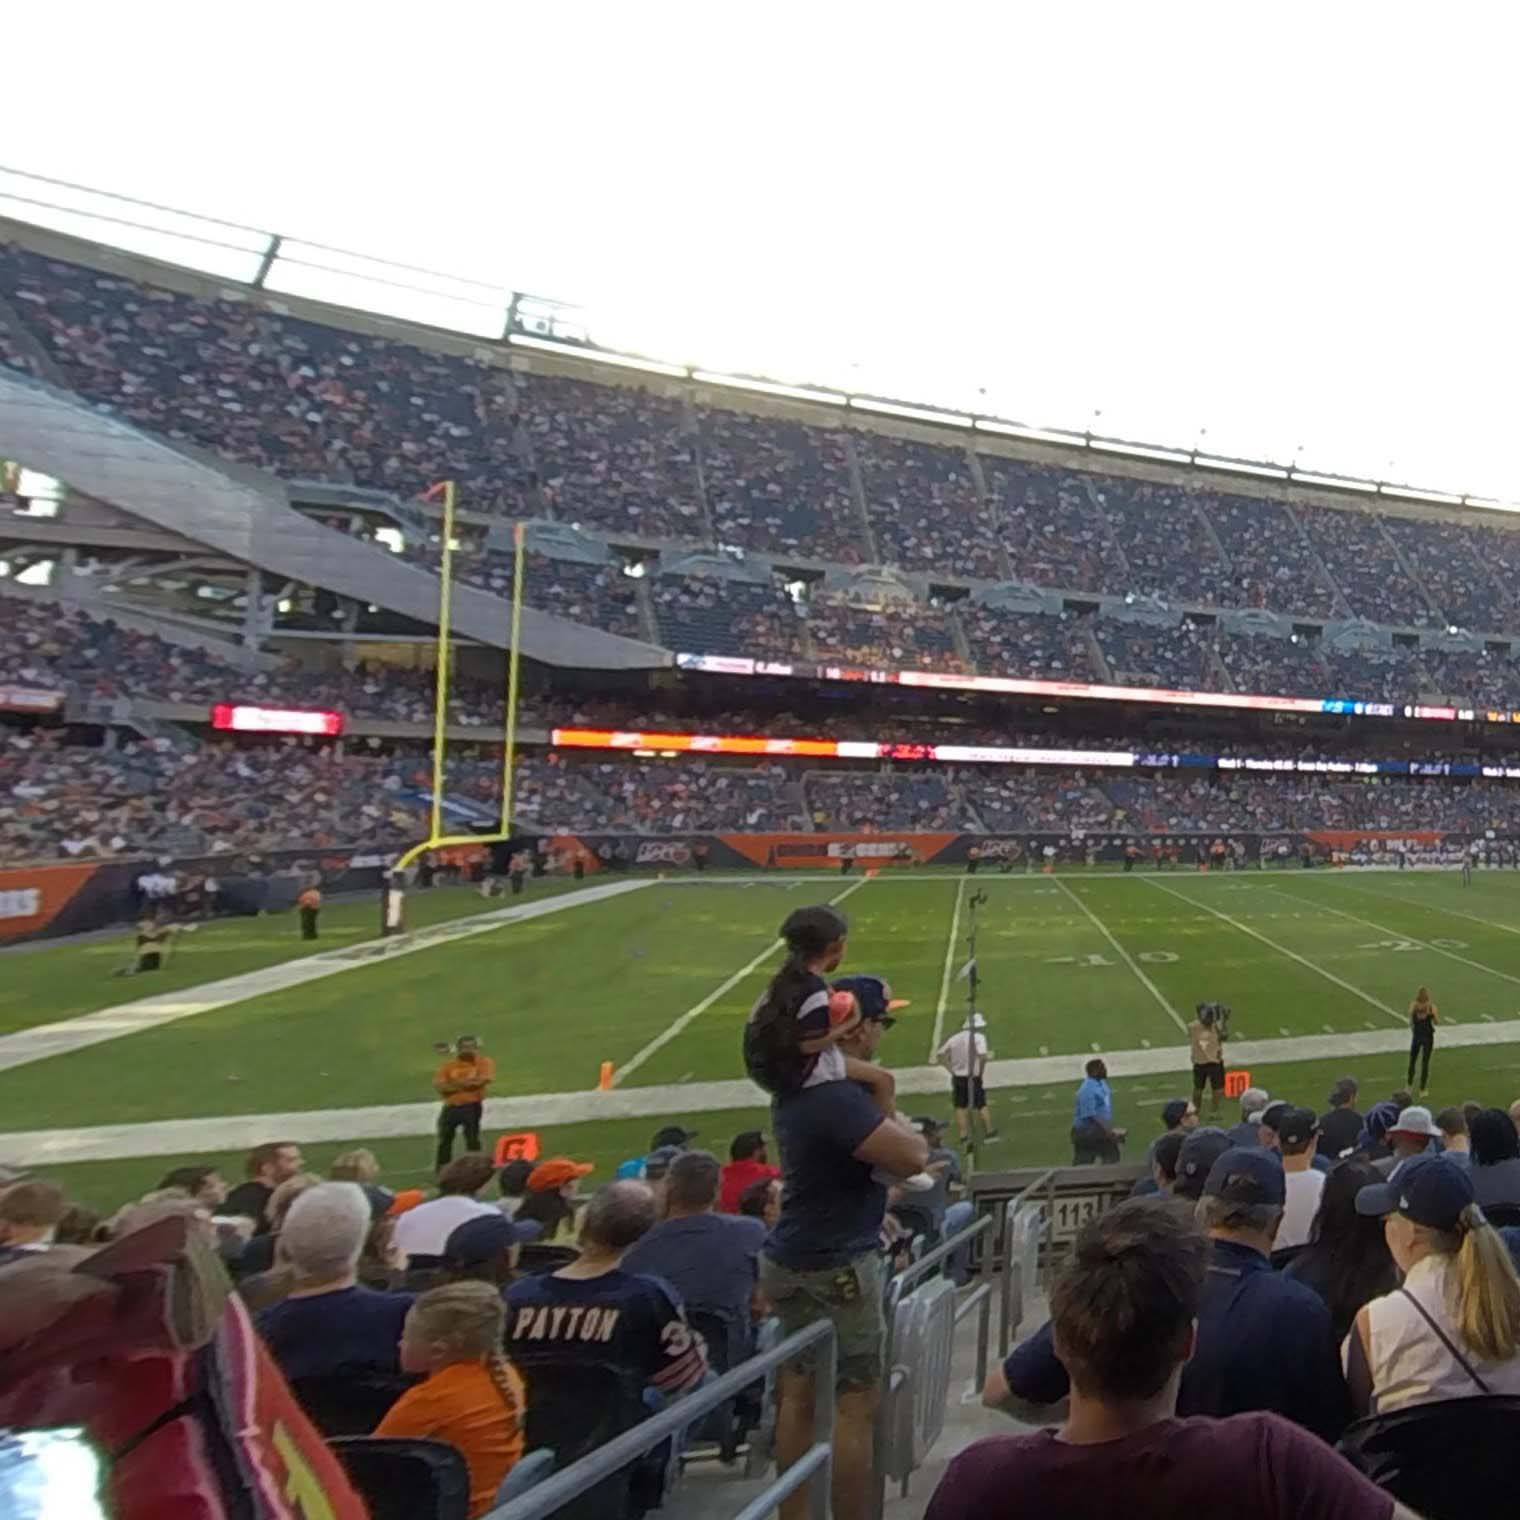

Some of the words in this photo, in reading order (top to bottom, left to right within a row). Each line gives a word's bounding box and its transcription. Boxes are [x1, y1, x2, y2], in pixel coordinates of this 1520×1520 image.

[1230, 1074, 1247, 1095] 10
[502, 1138, 527, 1162] G
[511, 1305, 621, 1343] PAYTON
